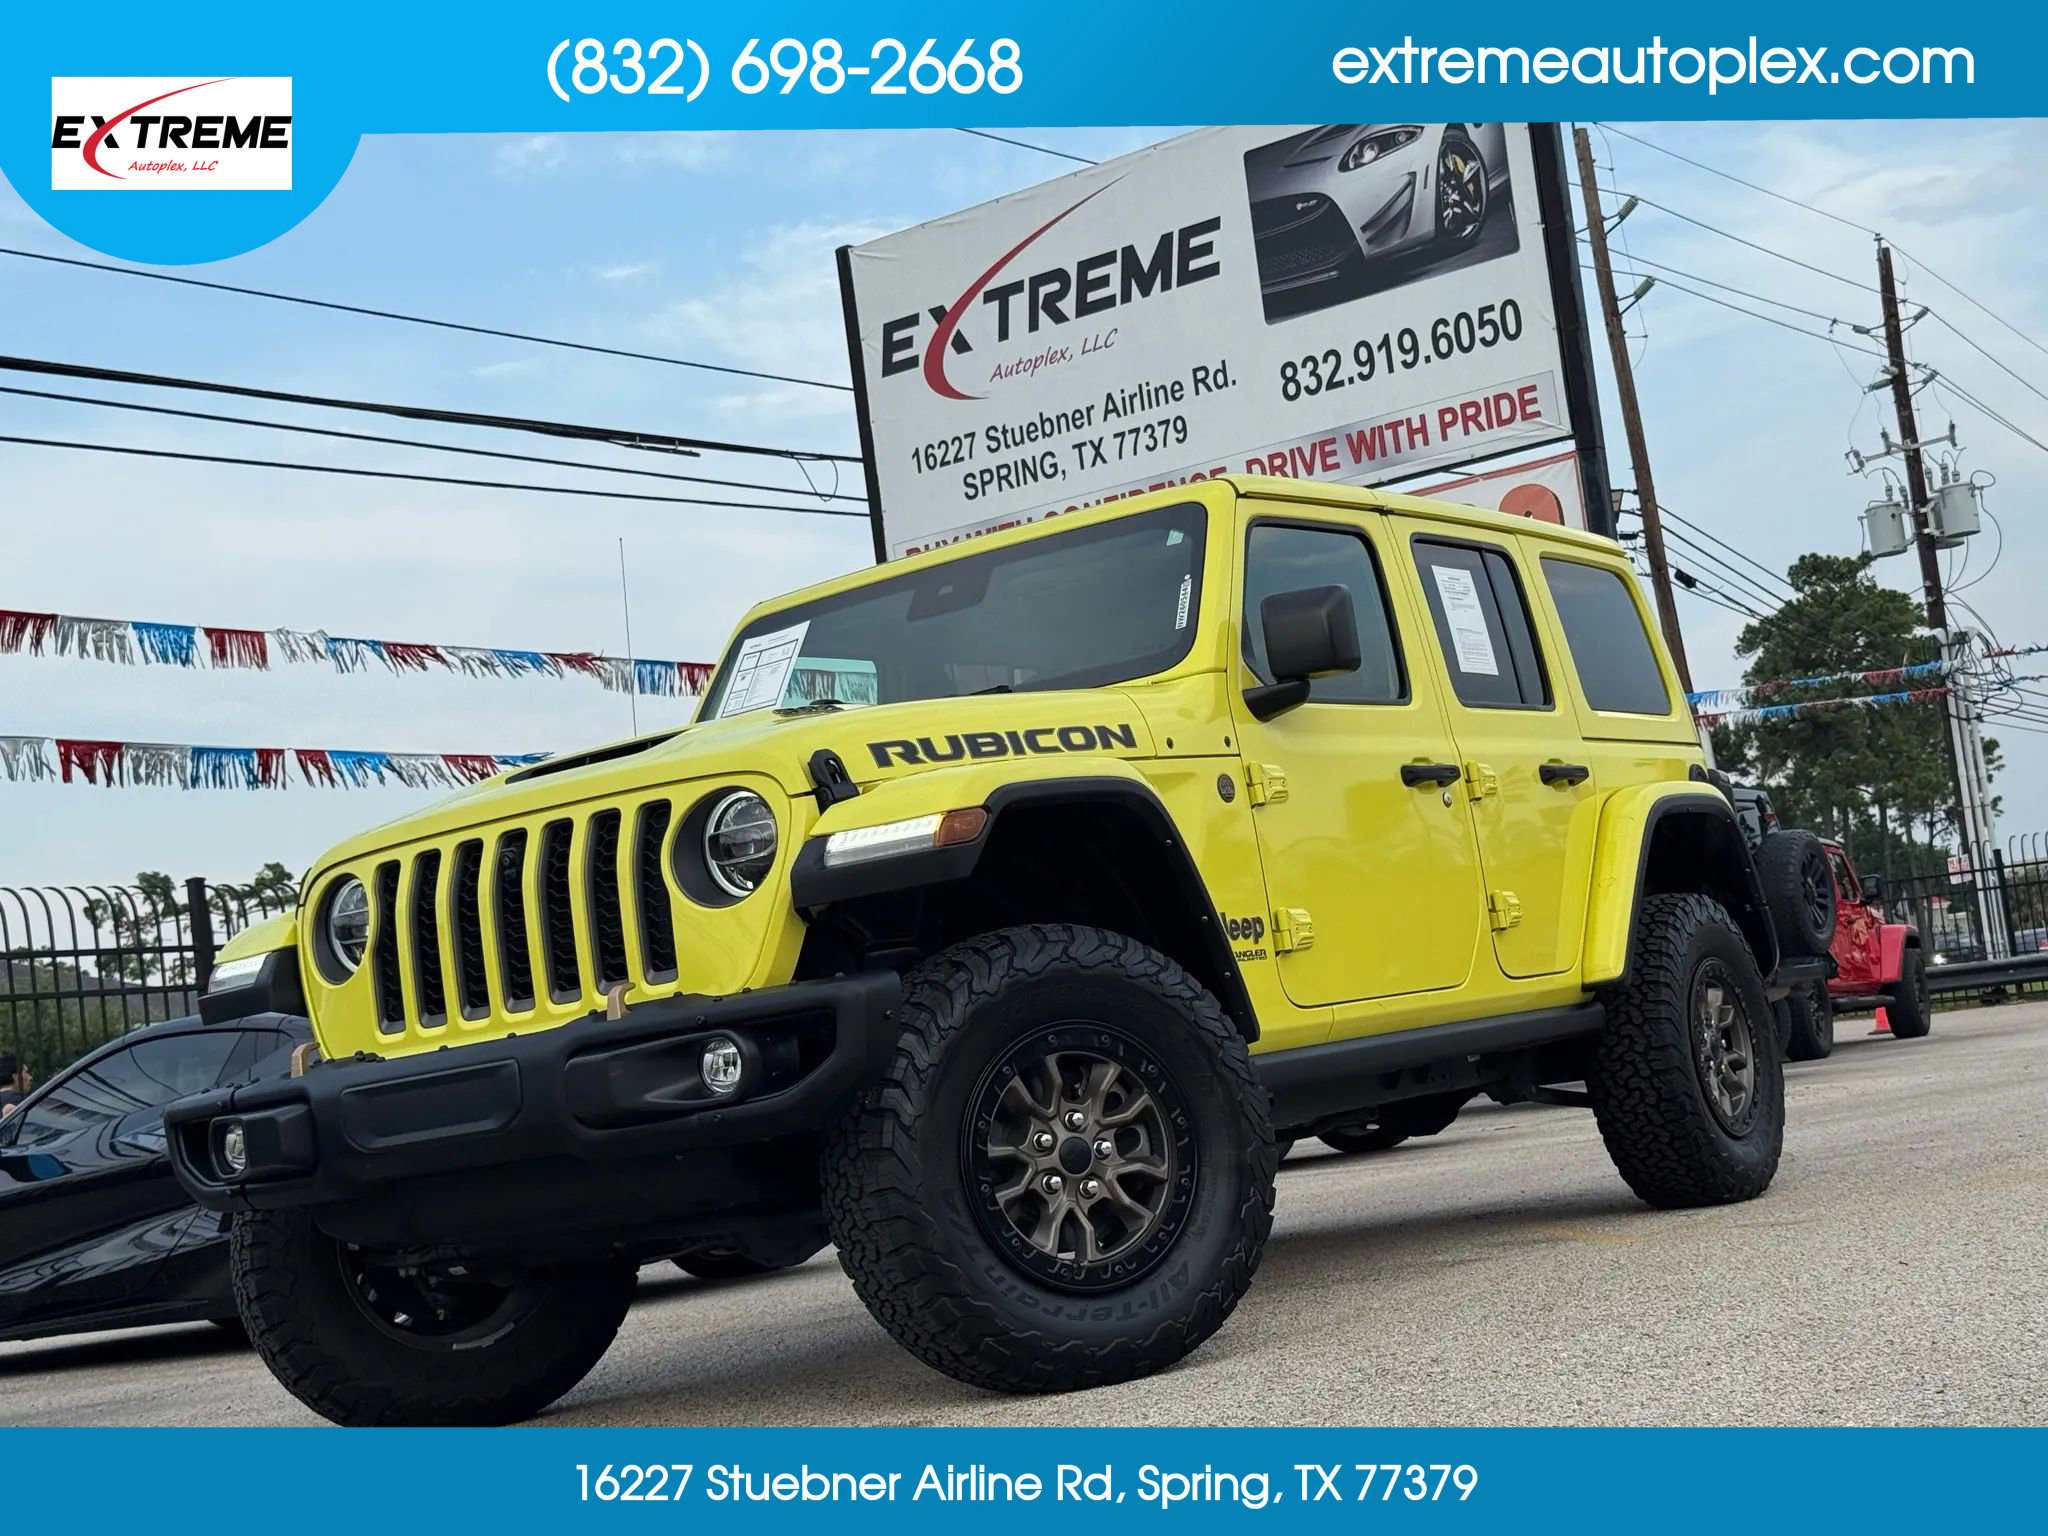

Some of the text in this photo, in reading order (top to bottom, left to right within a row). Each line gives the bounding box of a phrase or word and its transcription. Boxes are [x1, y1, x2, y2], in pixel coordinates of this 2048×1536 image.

[882, 216, 1221, 382] EXTREME
[990, 327, 1119, 383] Autoplex, LLC
[1280, 298, 1524, 402] 832.919.6050
[911, 359, 1238, 474] 16227 Stuebner Airline Rd.
[963, 451, 1068, 500] SPRING,
[1072, 436, 1108, 471] TX
[1113, 415, 1188, 461] 77379
[1346, 413, 1429, 464] WITH
[1438, 384, 1542, 441] PRIDE
[867, 723, 1138, 769] RUBICON
